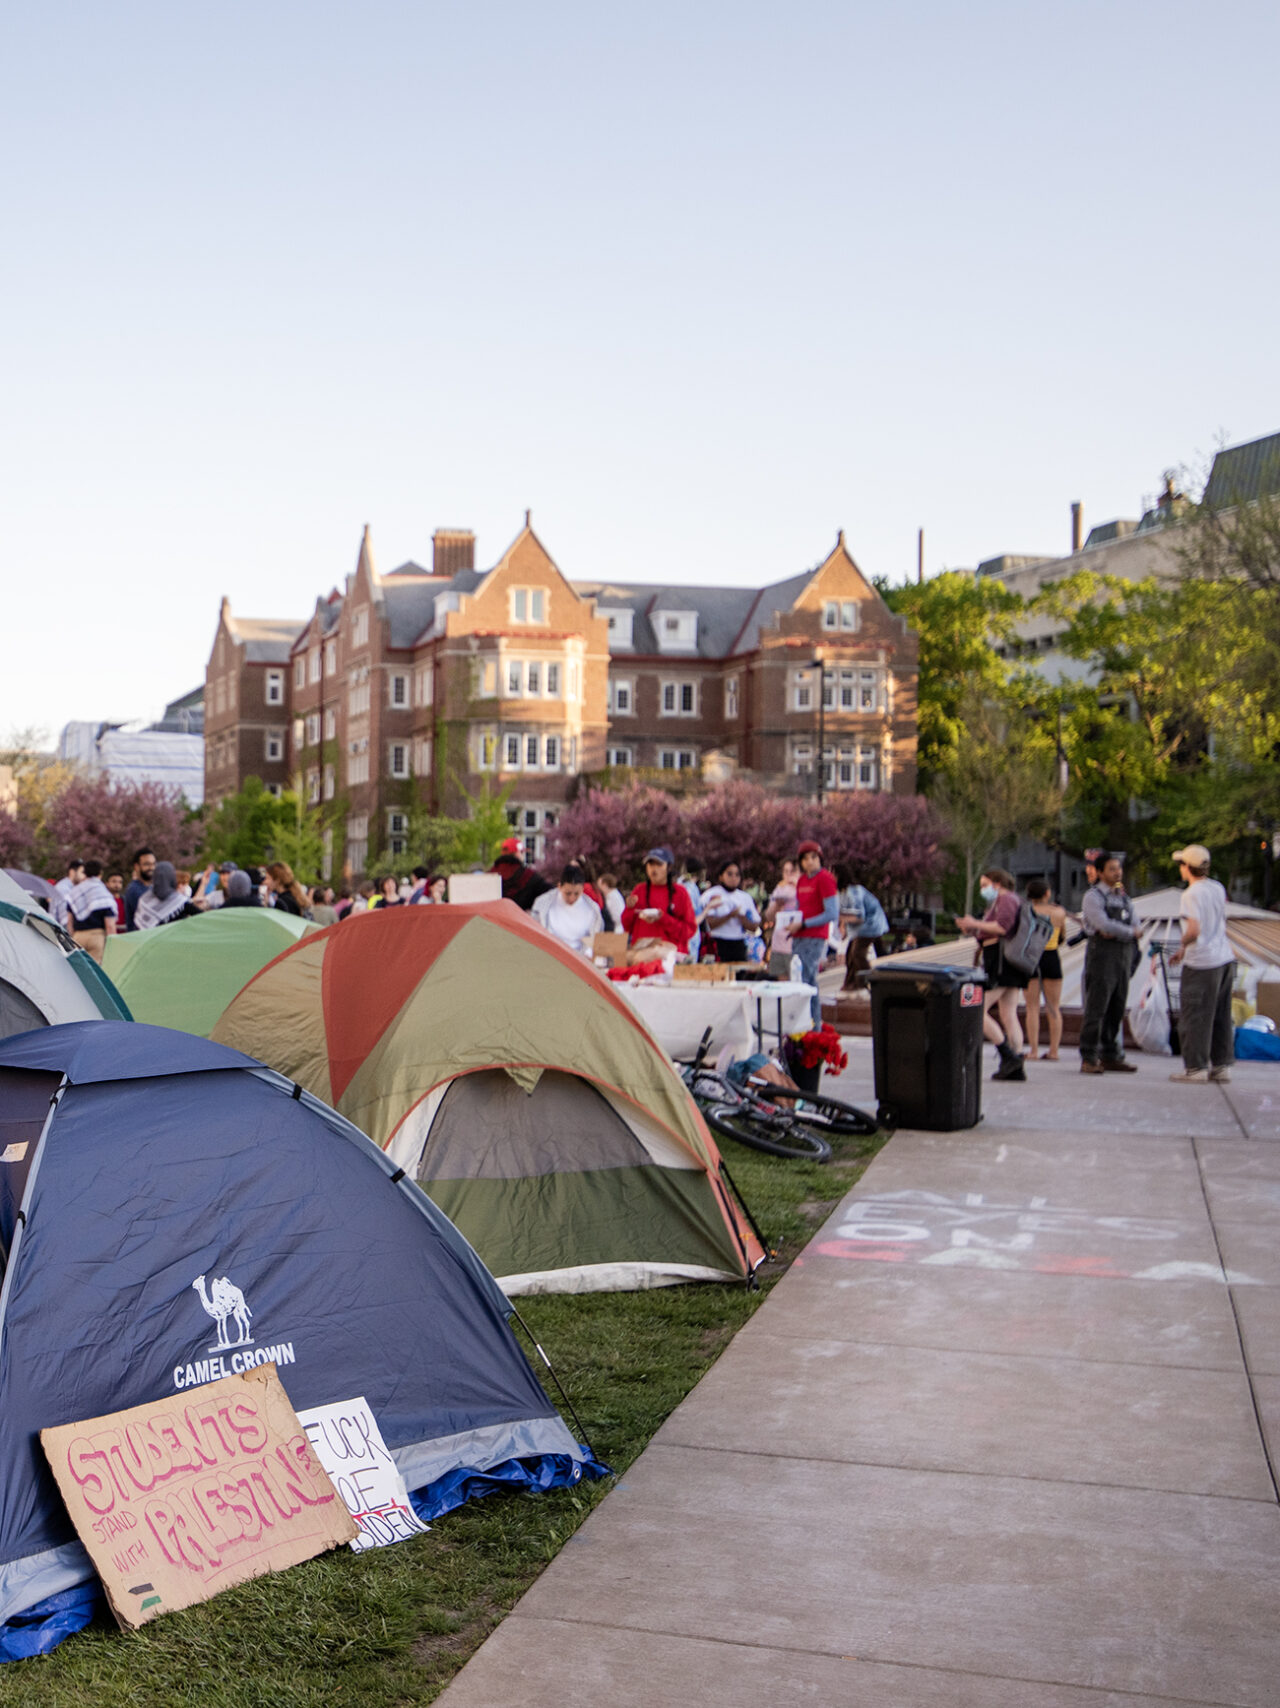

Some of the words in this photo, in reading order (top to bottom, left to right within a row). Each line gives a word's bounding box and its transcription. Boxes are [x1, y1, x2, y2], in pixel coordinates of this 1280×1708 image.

[173, 1356, 232, 1389] CAMEL
[231, 1342, 296, 1374] CROWN
[67, 1392, 268, 1516] STUDENTS
[143, 1434, 335, 1574] PALESTINE
[327, 1466, 390, 1513] OE
[91, 1510, 137, 1544] STAND
[112, 1539, 150, 1574] WITH
